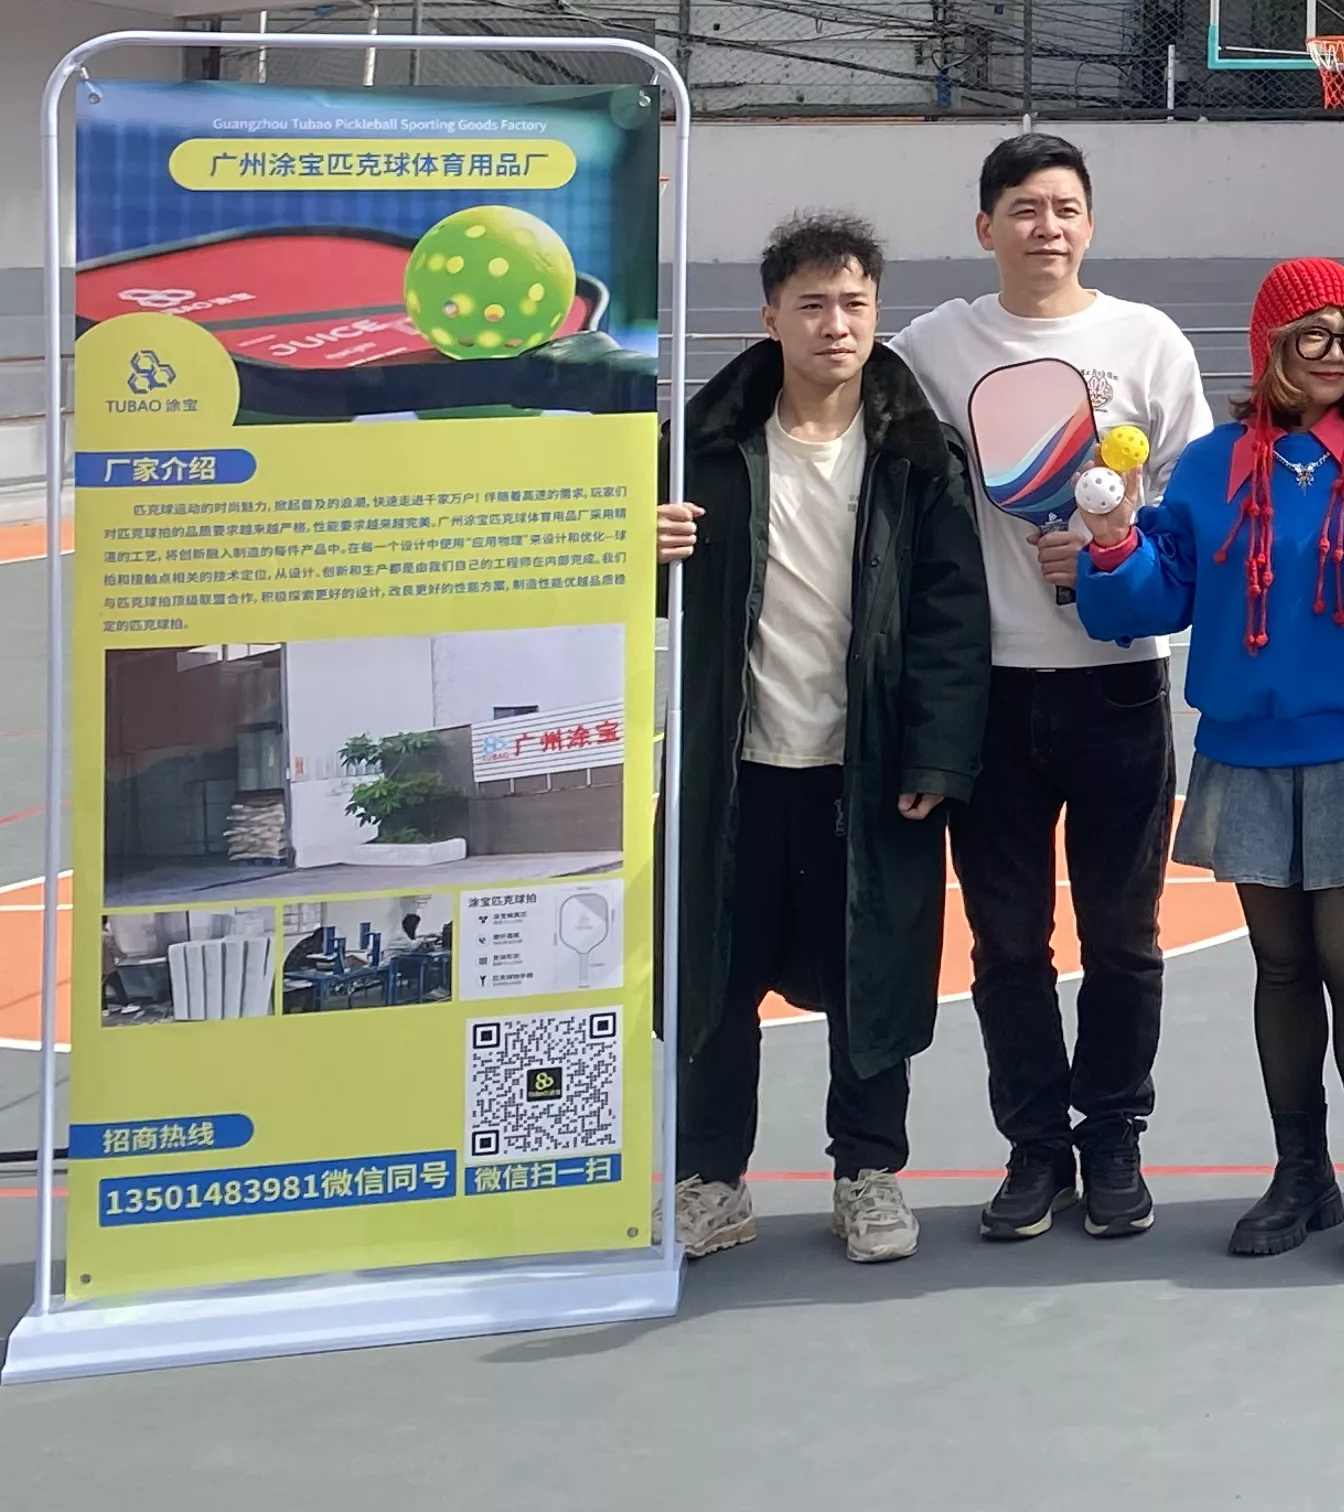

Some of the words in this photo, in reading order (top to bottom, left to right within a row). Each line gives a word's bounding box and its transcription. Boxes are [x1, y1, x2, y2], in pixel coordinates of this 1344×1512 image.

[213, 118, 288, 132] Guangzhou
[292, 118, 332, 131] Tubao
[335, 118, 398, 131] Pickleball
[401, 119, 456, 133] Sporting
[459, 119, 498, 131] Goods
[501, 119, 548, 133] Factory
[210, 152, 549, 178] 广州涂宝匹克球体育用品厂
[268, 319, 386, 356] JUICE
[106, 400, 162, 413] TUBAO
[166, 399, 197, 413] 涂宝
[104, 456, 217, 482] 厂家介绍
[515, 720, 620, 756] 广州涂宝
[468, 893, 537, 908] 涂宝匹克球拍
[103, 1122, 215, 1153] 招商热线
[106, 1160, 449, 1215] 13501483981微信同号
[474, 1157, 612, 1192] 微信扫一扫
